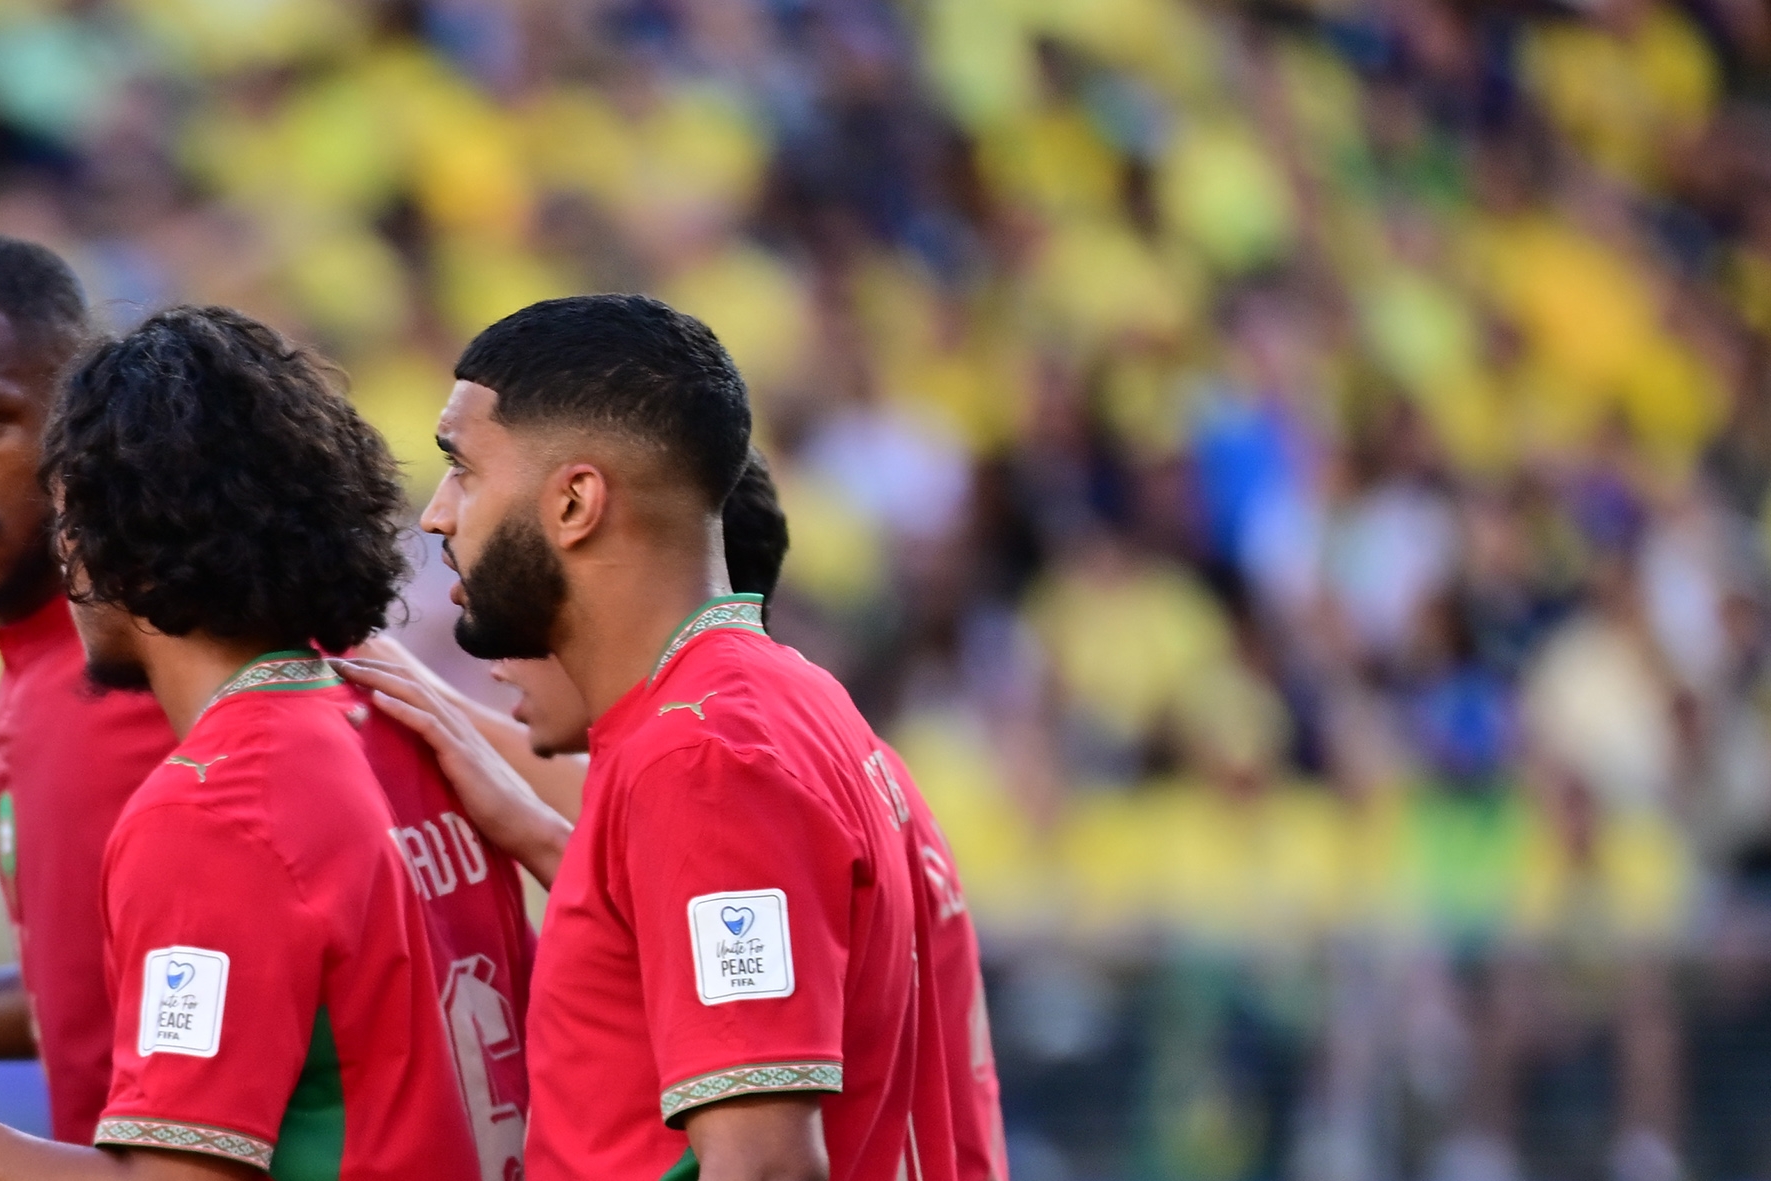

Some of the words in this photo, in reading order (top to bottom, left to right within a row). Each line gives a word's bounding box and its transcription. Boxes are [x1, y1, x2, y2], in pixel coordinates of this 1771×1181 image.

[746, 938, 765, 955] For
[721, 957, 765, 977] PEACE
[731, 978, 755, 988] FIFA
[158, 1011, 194, 1030] EACE
